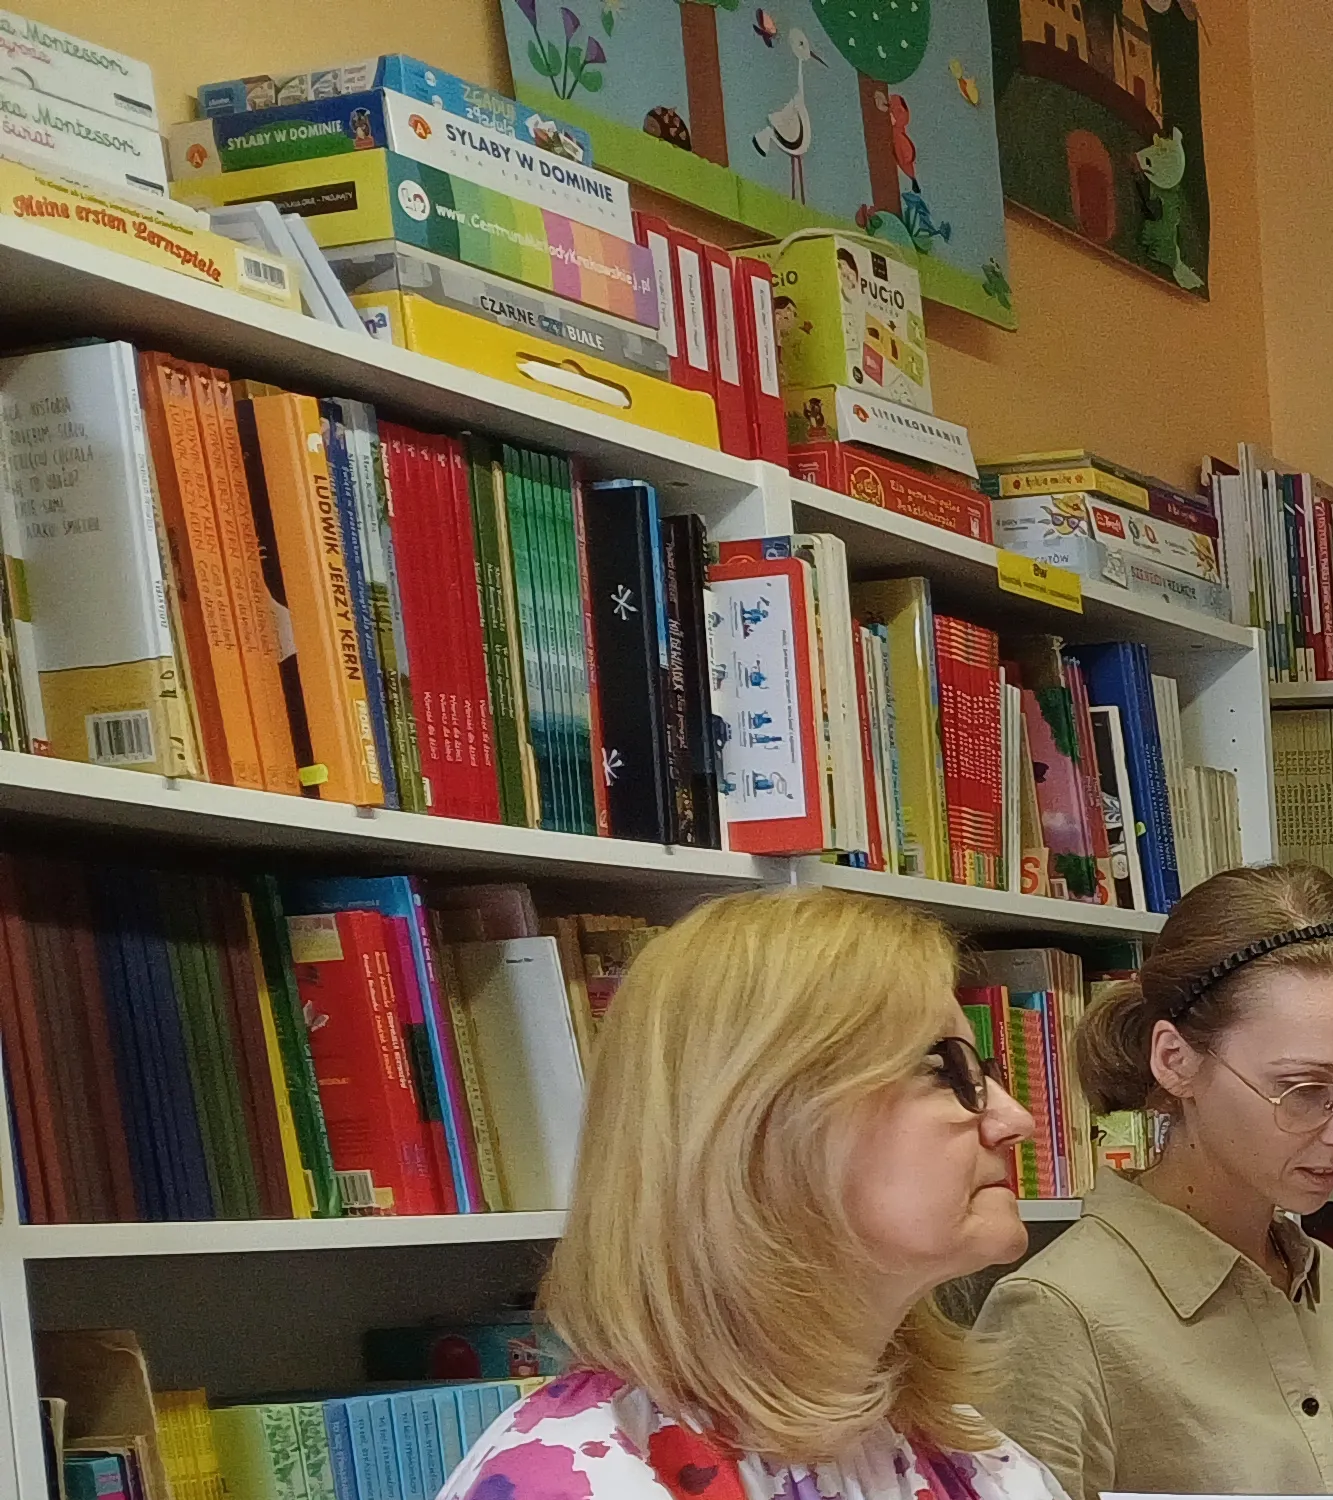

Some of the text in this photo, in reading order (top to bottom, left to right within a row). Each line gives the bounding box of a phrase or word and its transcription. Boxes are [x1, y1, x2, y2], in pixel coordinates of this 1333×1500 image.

[25, 20, 129, 76] Montessori
[32, 104, 141, 157] Montessori
[227, 119, 343, 151] SYLABY W DOMINIE
[446, 123, 614, 203] SYLABY W DOMINIE
[13, 195, 222, 283] Meine ersten Lernspiele
[480, 295, 536, 326] CZARNE
[313, 474, 362, 681] LUDWIK JERZY KERN
[1022, 856, 1040, 894] S
[1096, 870, 1109, 905] S
